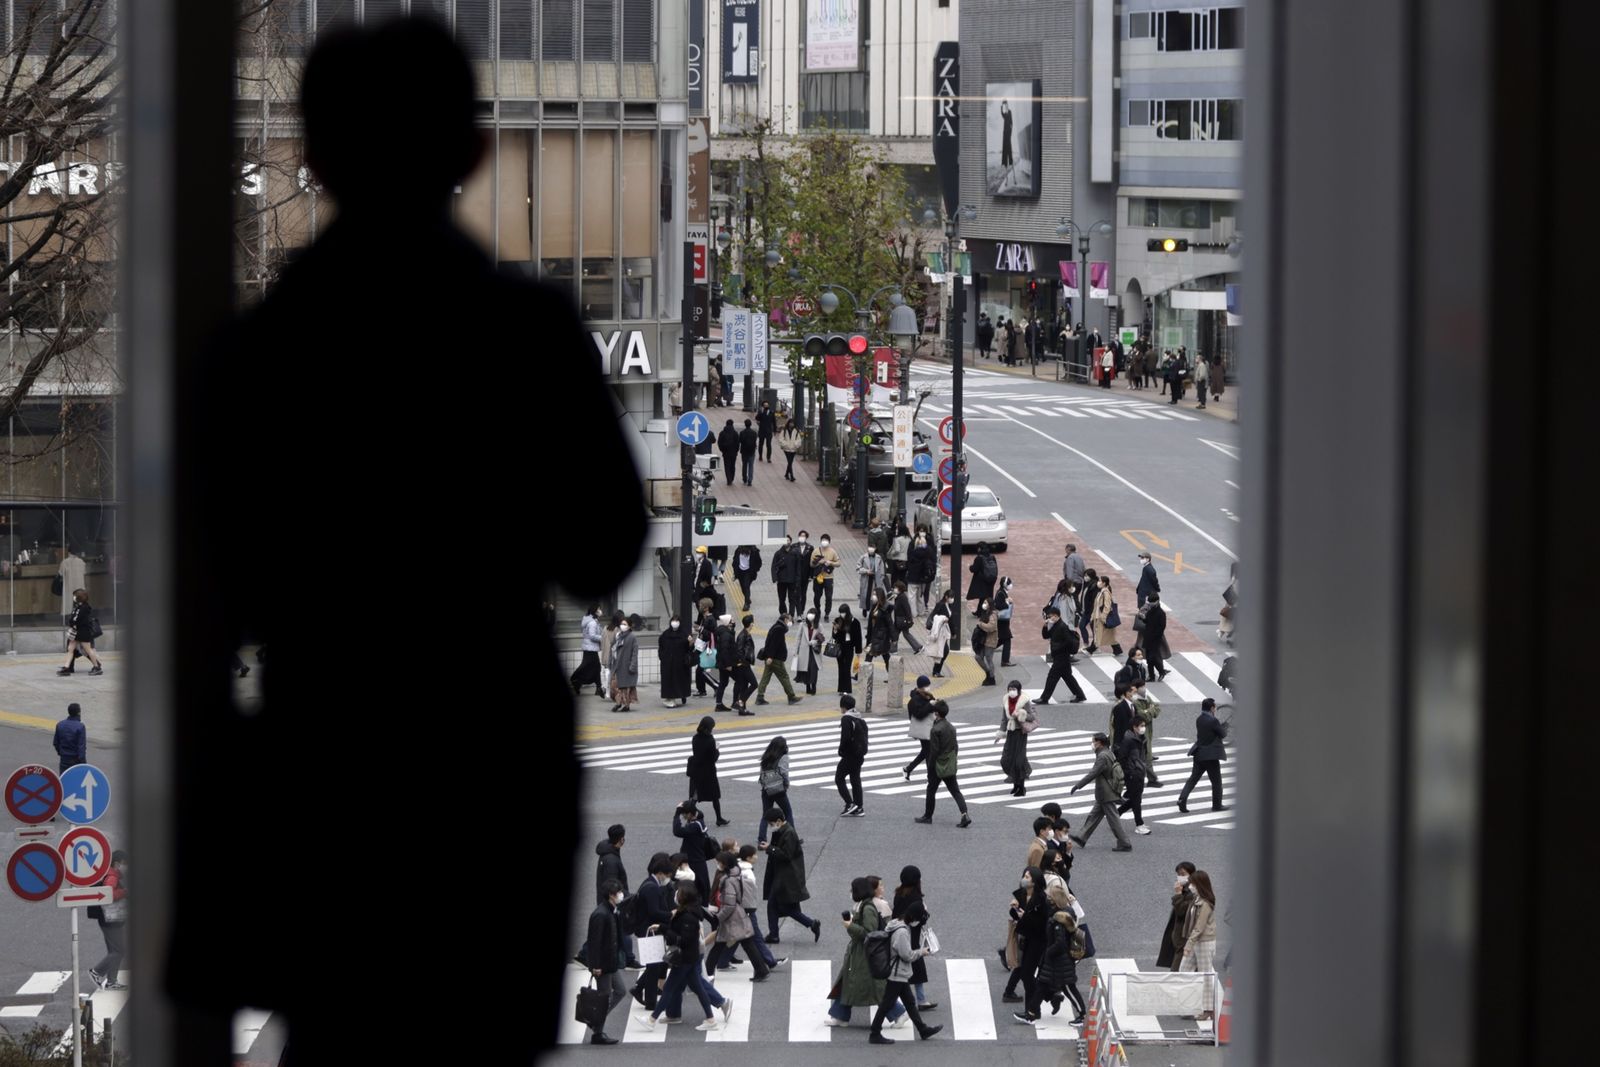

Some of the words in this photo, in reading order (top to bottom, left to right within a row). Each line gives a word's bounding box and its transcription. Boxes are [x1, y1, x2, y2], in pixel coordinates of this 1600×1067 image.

[937, 57, 956, 136] ZARA
[996, 242, 1035, 272] ZARA
[735, 314, 745, 369] 渋谷駅前
[755, 316, 763, 368] スクランブル式
